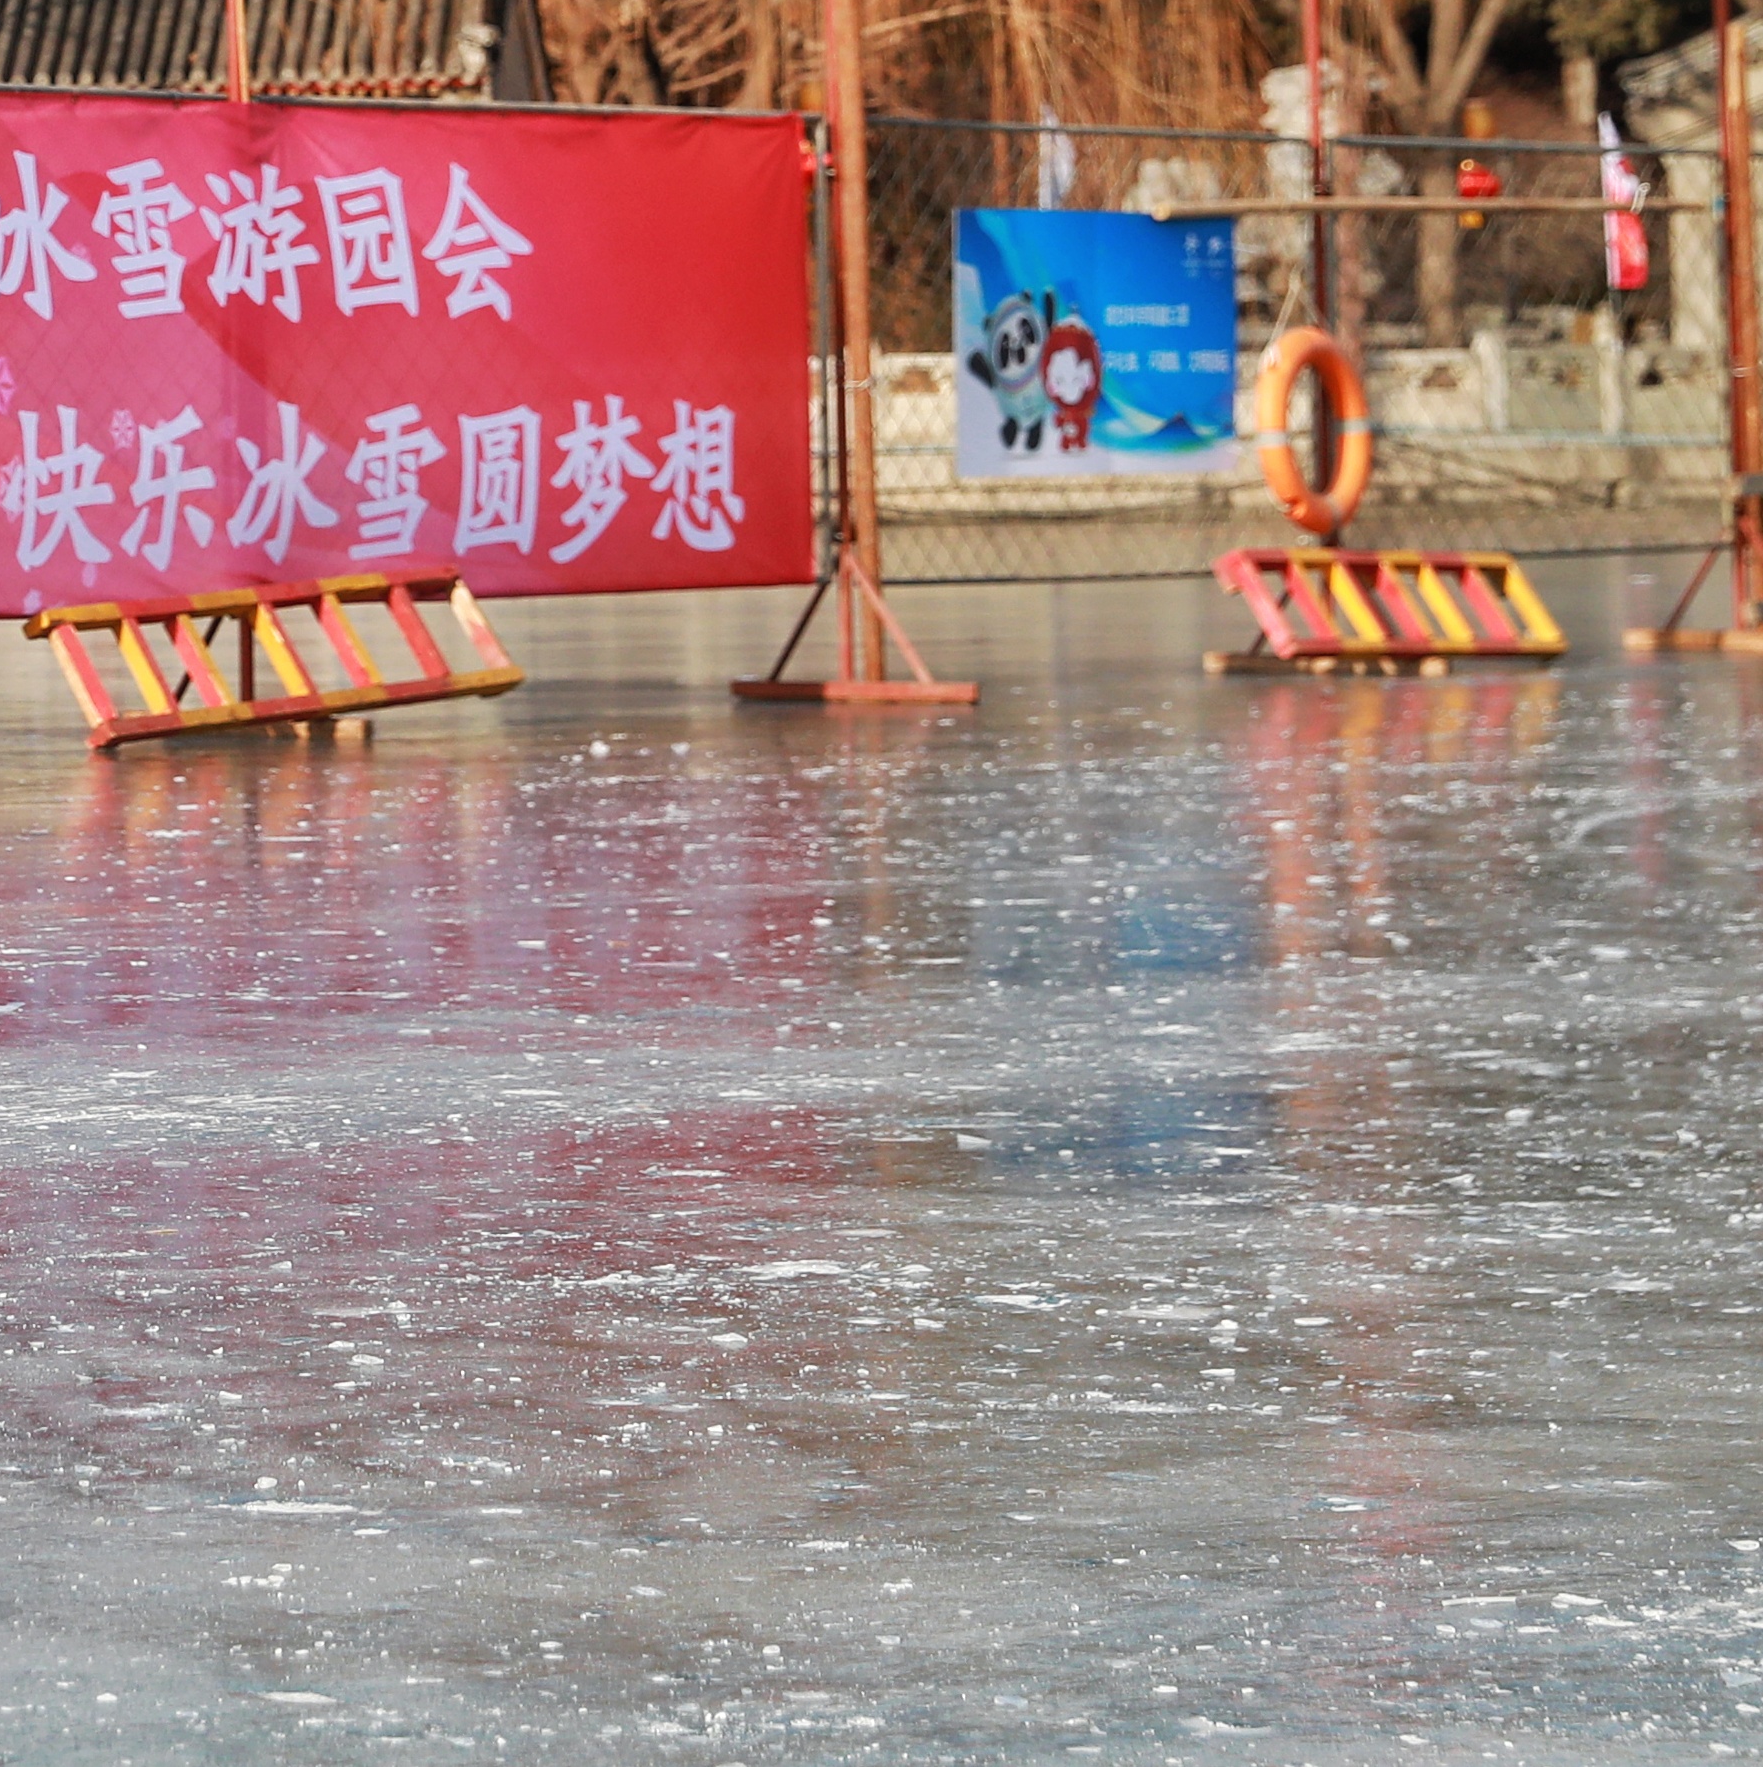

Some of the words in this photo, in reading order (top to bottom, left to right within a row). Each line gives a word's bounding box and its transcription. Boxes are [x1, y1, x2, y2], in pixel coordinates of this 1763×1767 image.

[15, 395, 745, 572] 快乐冰雪圆梦想
